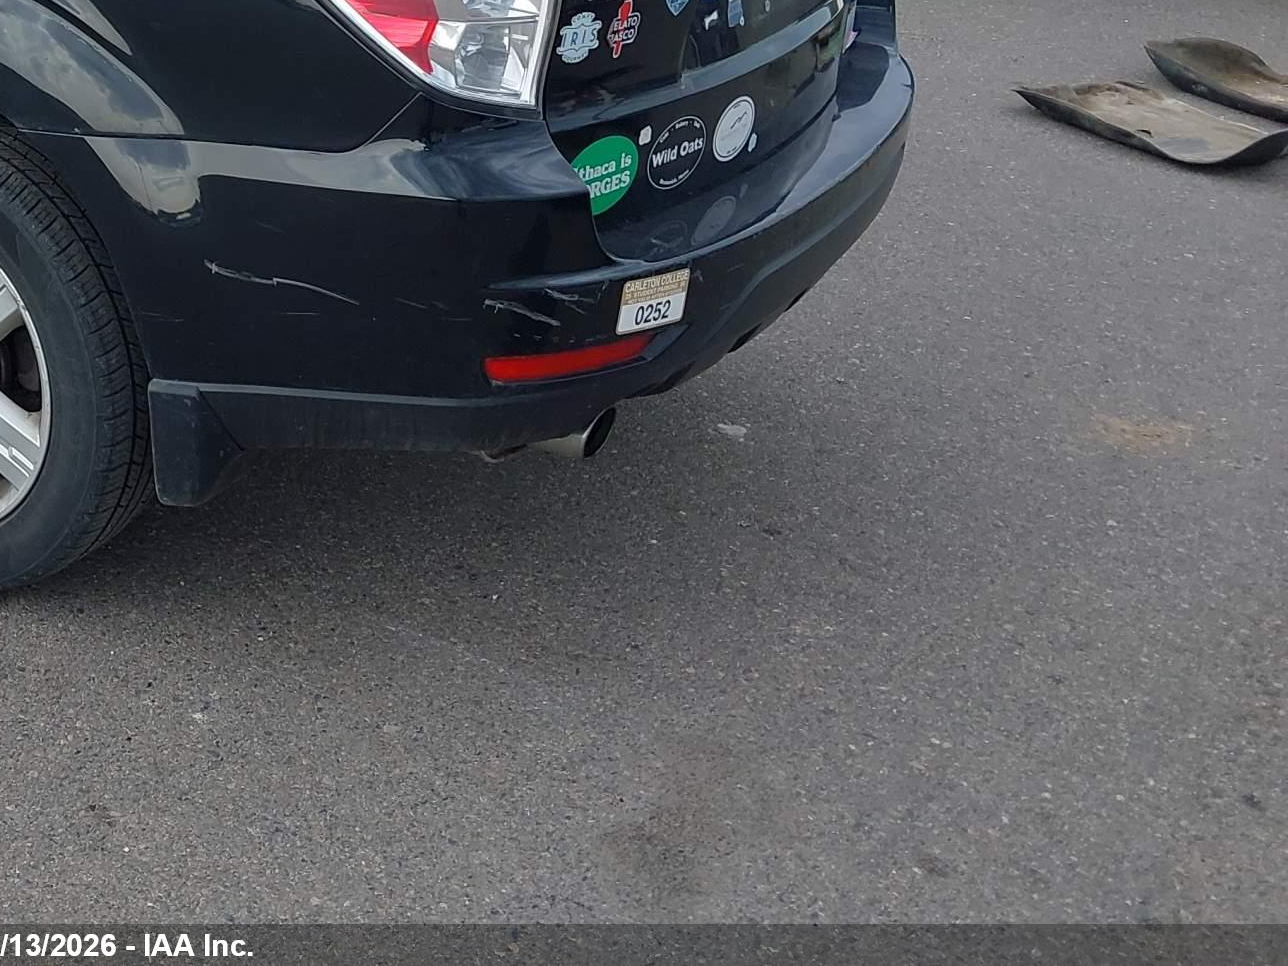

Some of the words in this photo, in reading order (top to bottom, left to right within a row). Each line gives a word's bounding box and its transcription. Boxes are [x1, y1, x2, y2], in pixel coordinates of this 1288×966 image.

[613, 16, 638, 32] ELATO
[562, 27, 598, 48] IRIS
[620, 152, 633, 168] is
[651, 144, 679, 169] Wild
[679, 137, 704, 157] Oats
[625, 276, 661, 293] CARLETON
[661, 269, 690, 286] COLLEGE
[634, 298, 672, 326] 0252
